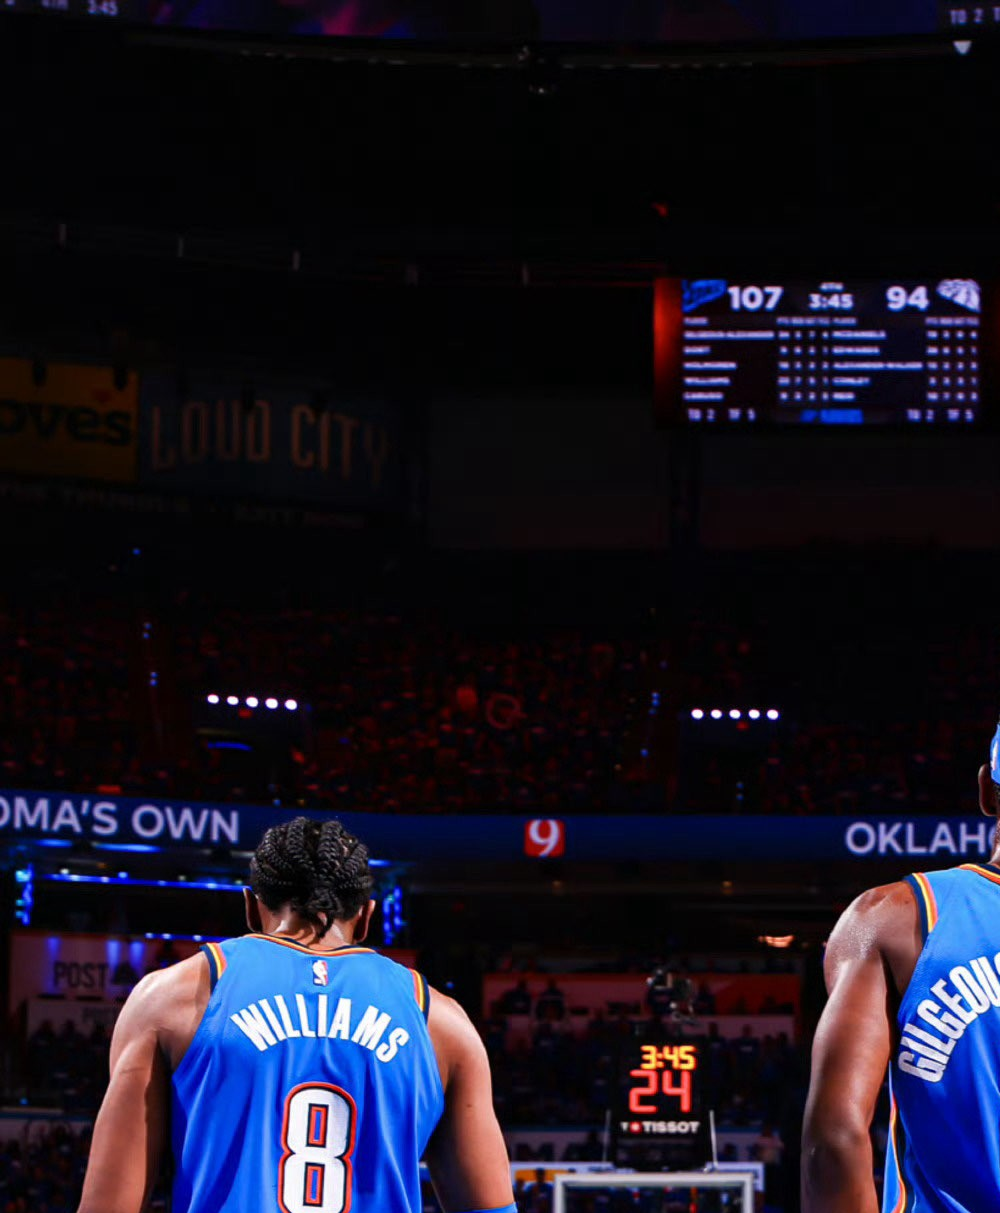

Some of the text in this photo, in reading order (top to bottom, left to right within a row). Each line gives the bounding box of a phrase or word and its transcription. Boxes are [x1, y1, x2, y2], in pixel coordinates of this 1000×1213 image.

[727, 285, 784, 311] 107
[809, 293, 854, 310] 3:45
[886, 285, 930, 311] 94
[150, 399, 388, 488] LOUD CITY
[131, 803, 240, 844] OWN
[529, 819, 559, 858] 9
[54, 961, 107, 989] POST
[230, 993, 409, 1063] WILLIAMS
[640, 1045, 697, 1070] 3:45
[628, 1069, 693, 1115] 24
[642, 1120, 700, 1135] TISSOT
